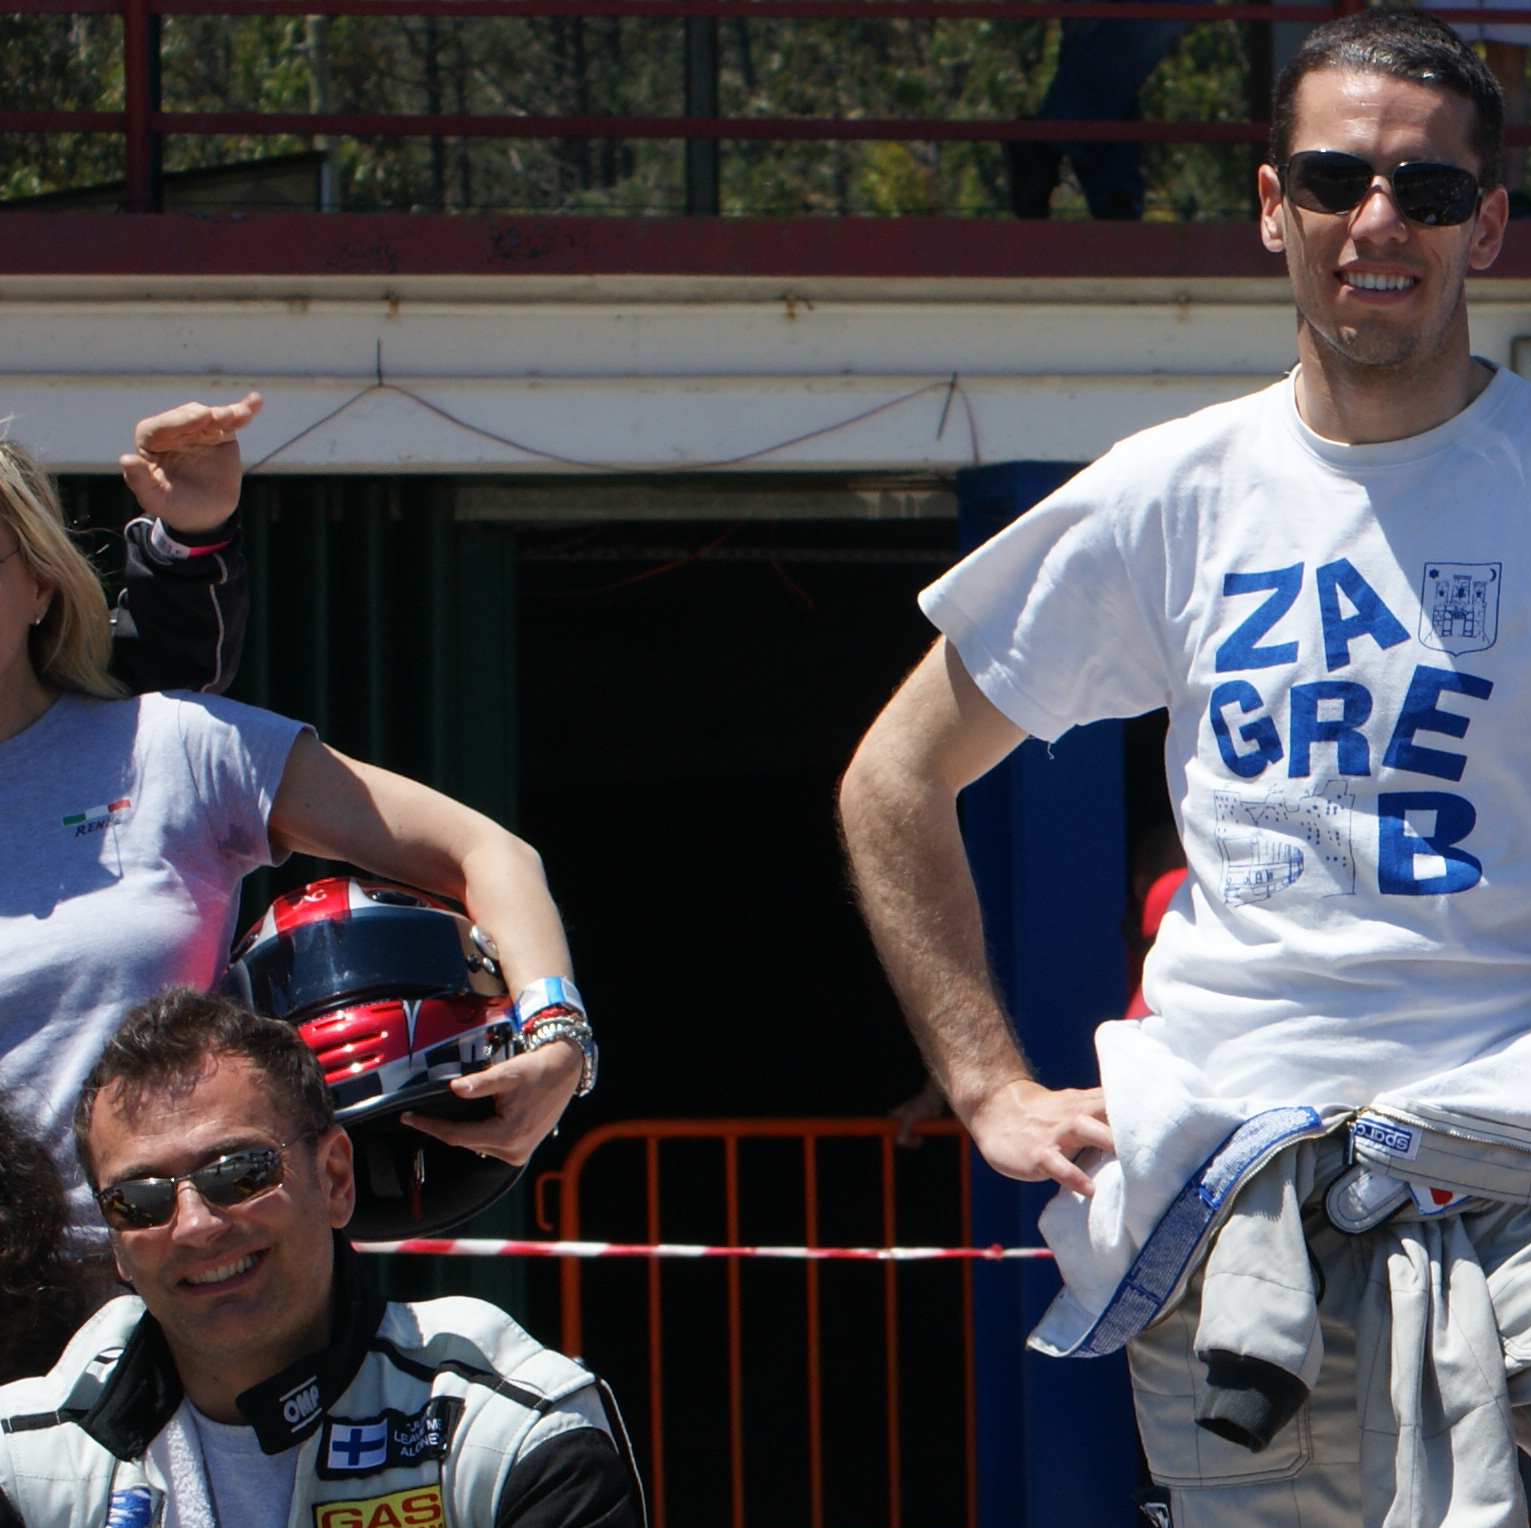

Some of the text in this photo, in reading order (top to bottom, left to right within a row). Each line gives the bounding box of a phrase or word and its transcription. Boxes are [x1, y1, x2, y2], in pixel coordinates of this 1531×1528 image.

[1215, 557, 1411, 673] ZA
[1209, 664, 1494, 782] GRE
[1377, 791, 1483, 895] B
[283, 1385, 320, 1423] OMP
